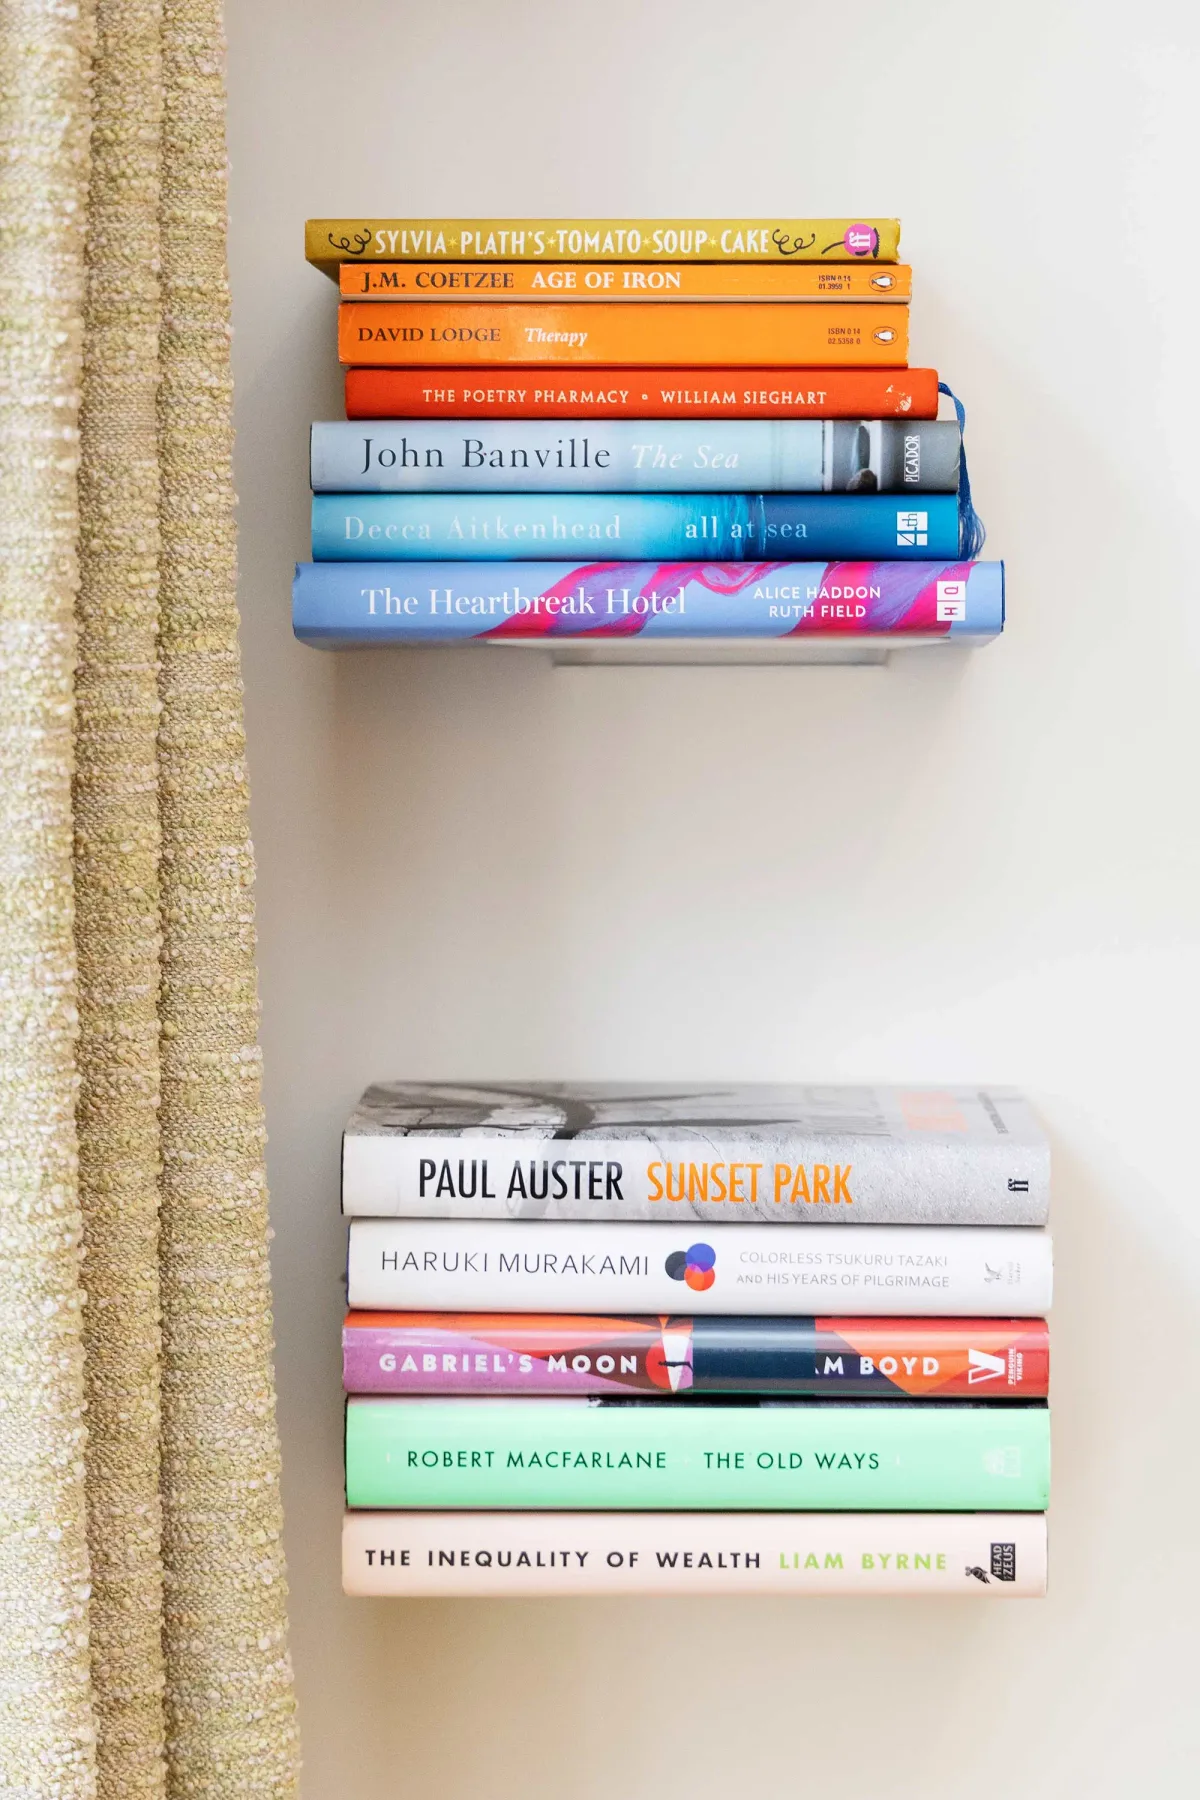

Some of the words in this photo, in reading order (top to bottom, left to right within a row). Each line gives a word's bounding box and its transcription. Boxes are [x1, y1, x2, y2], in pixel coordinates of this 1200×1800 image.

[375, 229, 447, 254] SYLVIA
[461, 230, 545, 255] PLATH'S
[556, 229, 641, 254] TOMATO
[652, 229, 708, 254] SOUP
[721, 229, 769, 254] CAKE
[361, 271, 406, 293] J.M.
[416, 271, 514, 289] COETZEE
[531, 271, 577, 289] AGE
[585, 271, 615, 289] OF
[623, 271, 681, 289] IRON
[358, 328, 424, 342] DAVID
[430, 328, 500, 342] LODGE
[524, 327, 587, 347] Therapy
[423, 389, 455, 404] THE
[464, 389, 526, 404] POETRY
[535, 389, 629, 404] PHARMACY
[661, 390, 738, 405] WILLIAM
[743, 391, 827, 405] SIEGHART
[361, 438, 444, 474] John
[462, 438, 611, 468] Banville
[632, 444, 682, 469] The
[694, 445, 739, 469] Sea
[905, 435, 919, 482] PICADOR
[344, 516, 431, 540] Decca
[447, 515, 621, 540] Aitkenhead
[685, 516, 717, 538] all
[730, 519, 754, 538] at
[767, 521, 808, 538] sea
[361, 588, 419, 615] The
[429, 587, 595, 615] Heartbreak
[605, 587, 686, 615] Hotel
[753, 586, 804, 600] ALICE
[806, 586, 881, 600] HADDON
[769, 604, 815, 618] RUTH
[821, 604, 866, 618] FIELD
[419, 1158, 496, 1198] PAUL
[507, 1160, 624, 1200] AUSTER
[647, 1162, 763, 1202] SUNSET
[774, 1163, 853, 1204] PARK
[382, 1251, 487, 1272] HARUKI
[500, 1253, 648, 1275] MURAKAMI
[740, 1252, 822, 1266] COLORLESS
[826, 1253, 893, 1267] TSUKURU
[897, 1254, 947, 1267] TAZAKI
[737, 1274, 762, 1284] AND
[767, 1273, 789, 1285] HIS
[792, 1273, 837, 1286] YEARS
[840, 1274, 860, 1286] OF
[863, 1274, 949, 1288] PILGRIMAGE
[379, 1353, 533, 1374] GABRIEL'S
[548, 1354, 637, 1374] MOON
[860, 1356, 939, 1376] BOYD
[407, 1451, 494, 1468] ROBERT
[507, 1451, 666, 1469] MACFARLANE
[704, 1452, 745, 1469] THE
[757, 1452, 802, 1470] OLD
[815, 1453, 879, 1470] WAYS
[365, 1550, 410, 1566] THE
[428, 1550, 589, 1568] INEQUALITY
[607, 1552, 639, 1568] OF
[656, 1552, 760, 1568] WEALTH
[779, 1553, 844, 1569] LIAM
[862, 1553, 946, 1569] BYRNE
[993, 1545, 1002, 1575] HEAD
[1003, 1545, 1013, 1575] ZEUS
